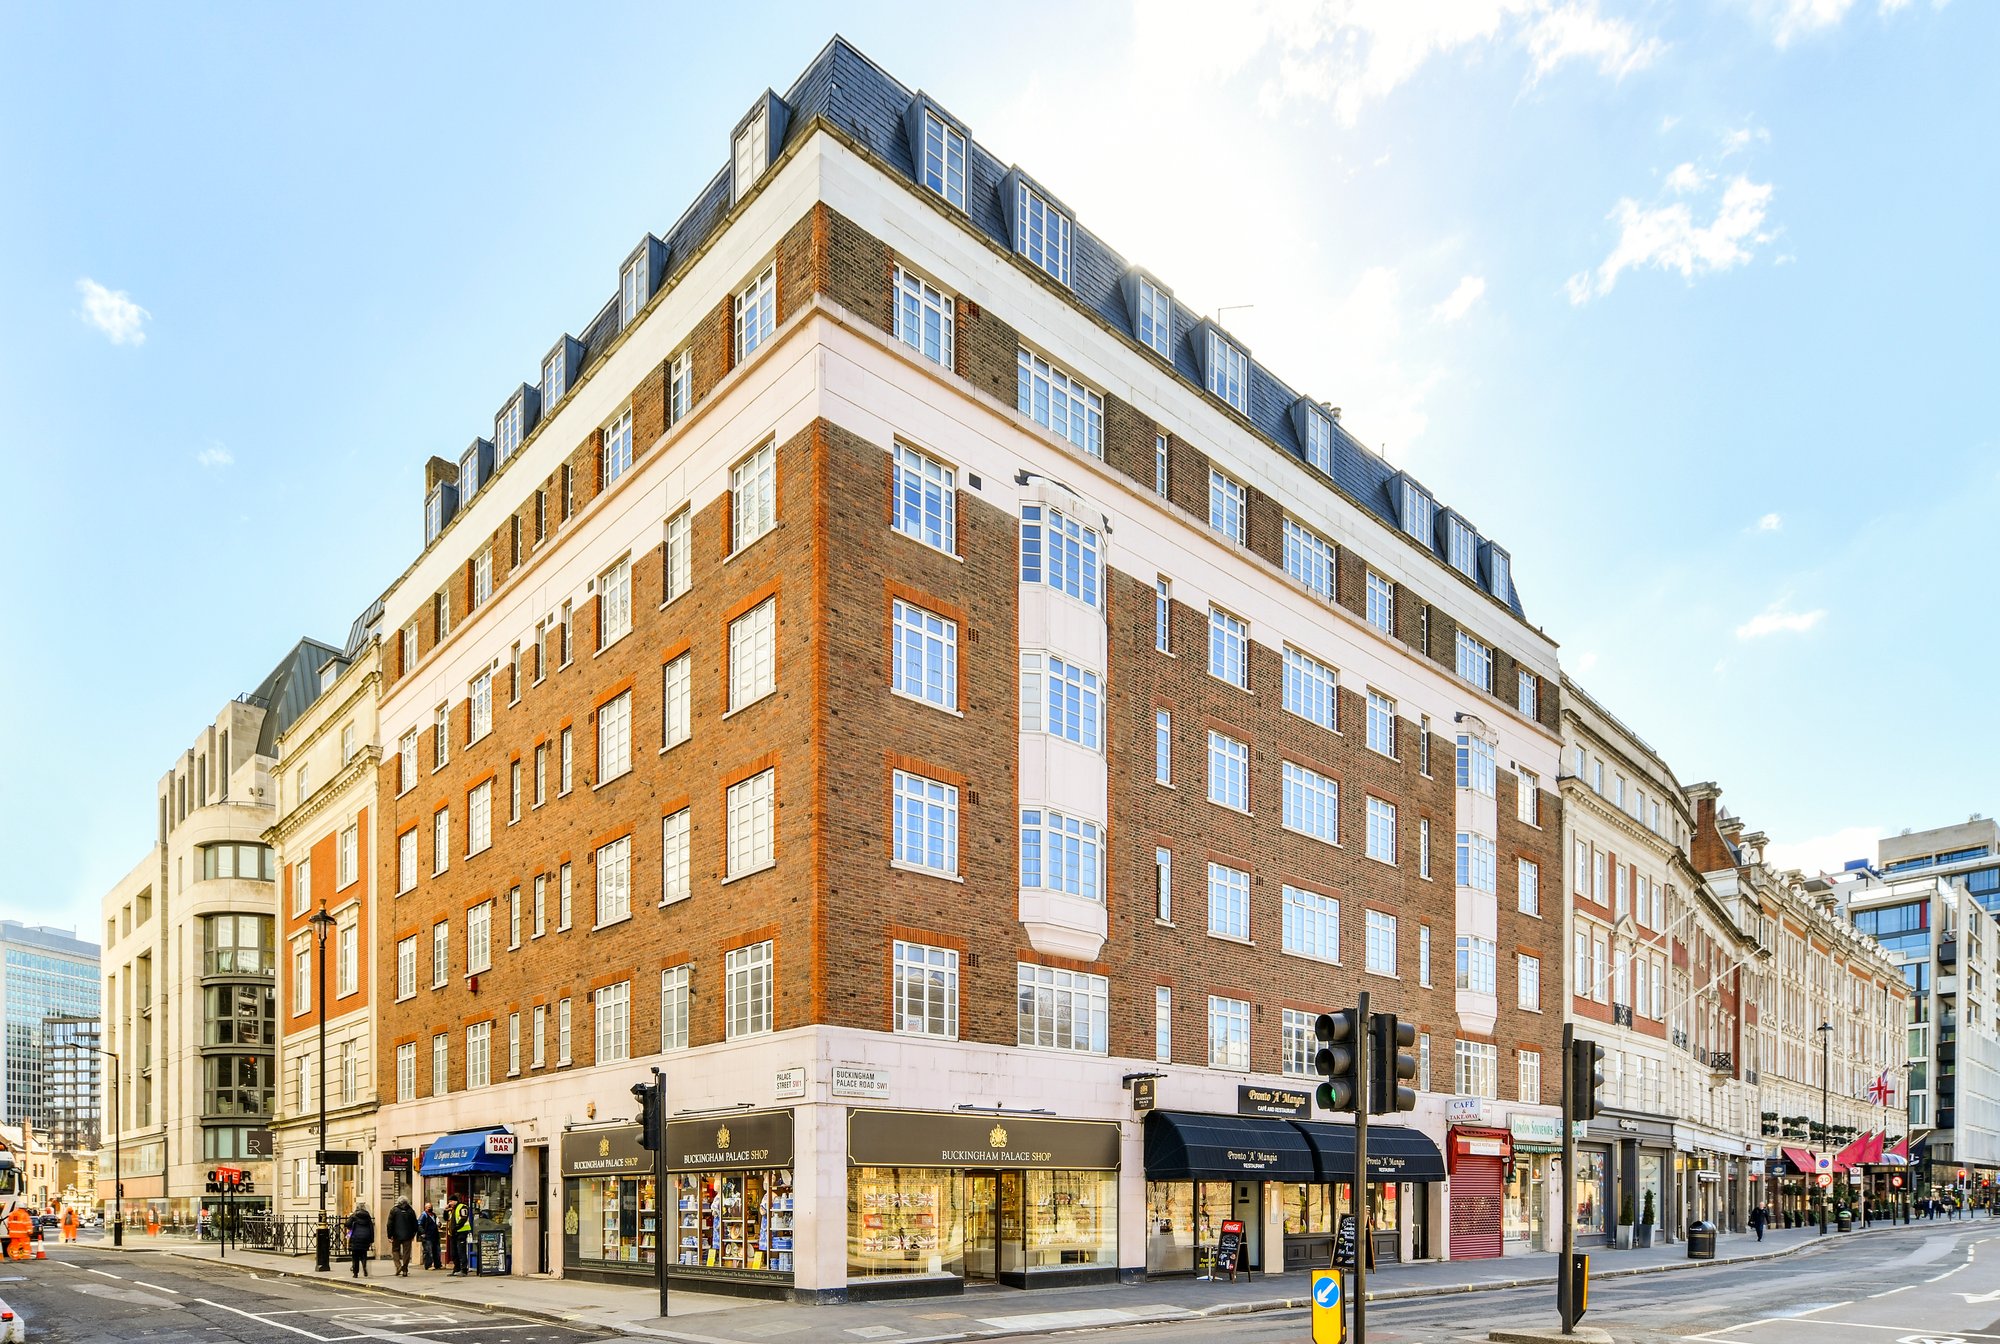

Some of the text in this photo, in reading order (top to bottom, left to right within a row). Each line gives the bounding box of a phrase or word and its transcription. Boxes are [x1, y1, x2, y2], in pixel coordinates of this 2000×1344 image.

[837, 1071, 874, 1080] BUCKINGHAM
[1248, 1090, 1271, 1101] Pronto
[1282, 1093, 1305, 1107] Mangia
[1454, 1099, 1474, 1108] CAFÉ
[684, 1150, 768, 1164] BUCKINGHAM PALACE SHOP
[942, 1150, 1052, 1161] BUCKINGHAM PALACE SHOP
[1227, 1150, 1246, 1160] Pronto
[1257, 1152, 1277, 1164] Mangia
[574, 1158, 638, 1170] BUCKINGHAM PALACE SHOP
[515, 1189, 519, 1198] 4
[553, 1187, 557, 1197] 4
